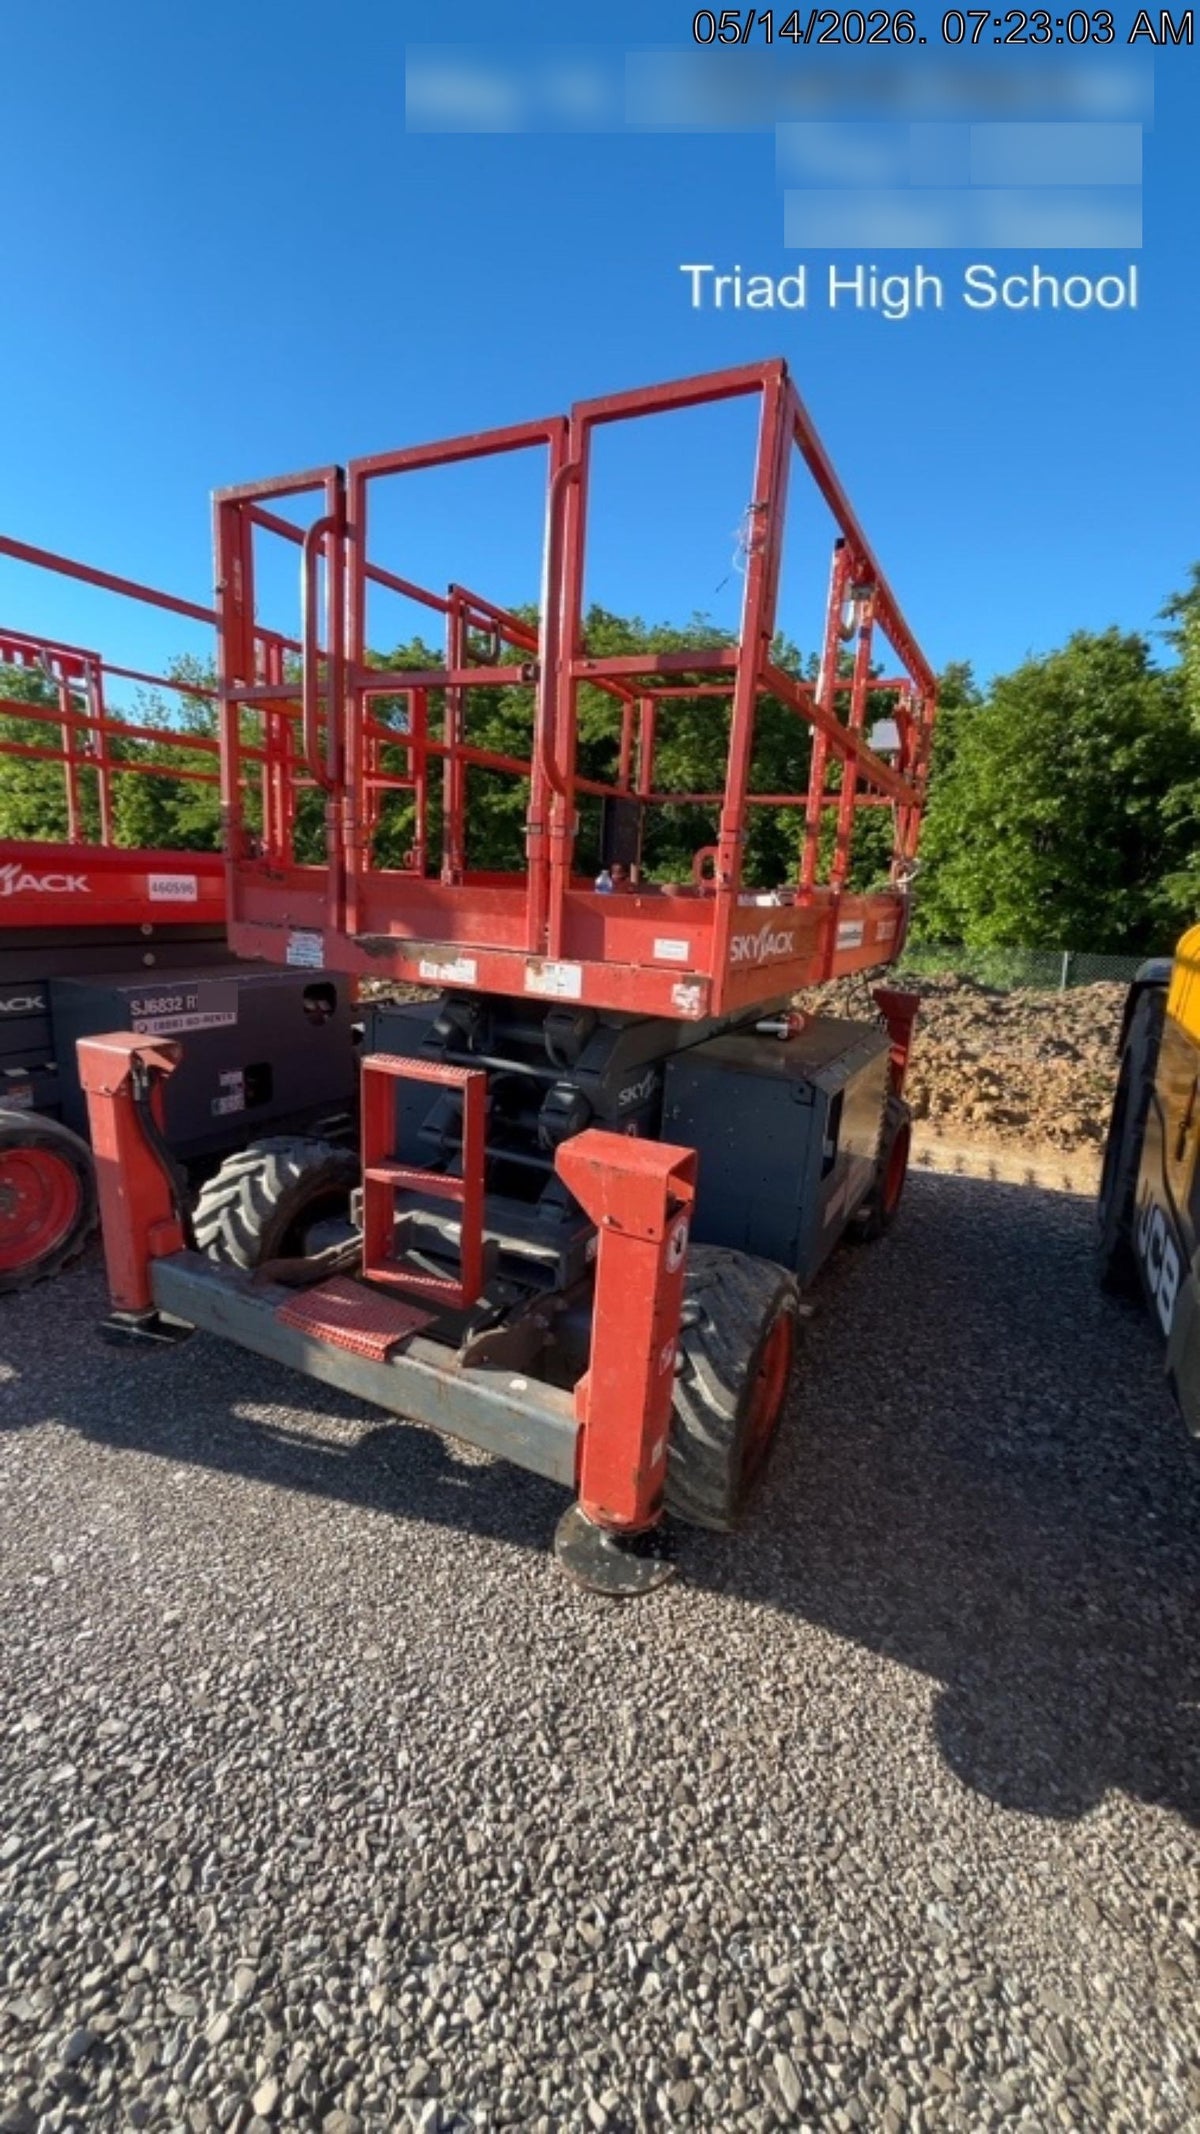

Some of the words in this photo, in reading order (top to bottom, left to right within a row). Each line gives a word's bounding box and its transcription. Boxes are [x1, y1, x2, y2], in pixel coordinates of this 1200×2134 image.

[0, 862, 92, 897] JACK
[730, 921, 794, 963] SKYJACK
[130, 996, 183, 1017] SJ6832
